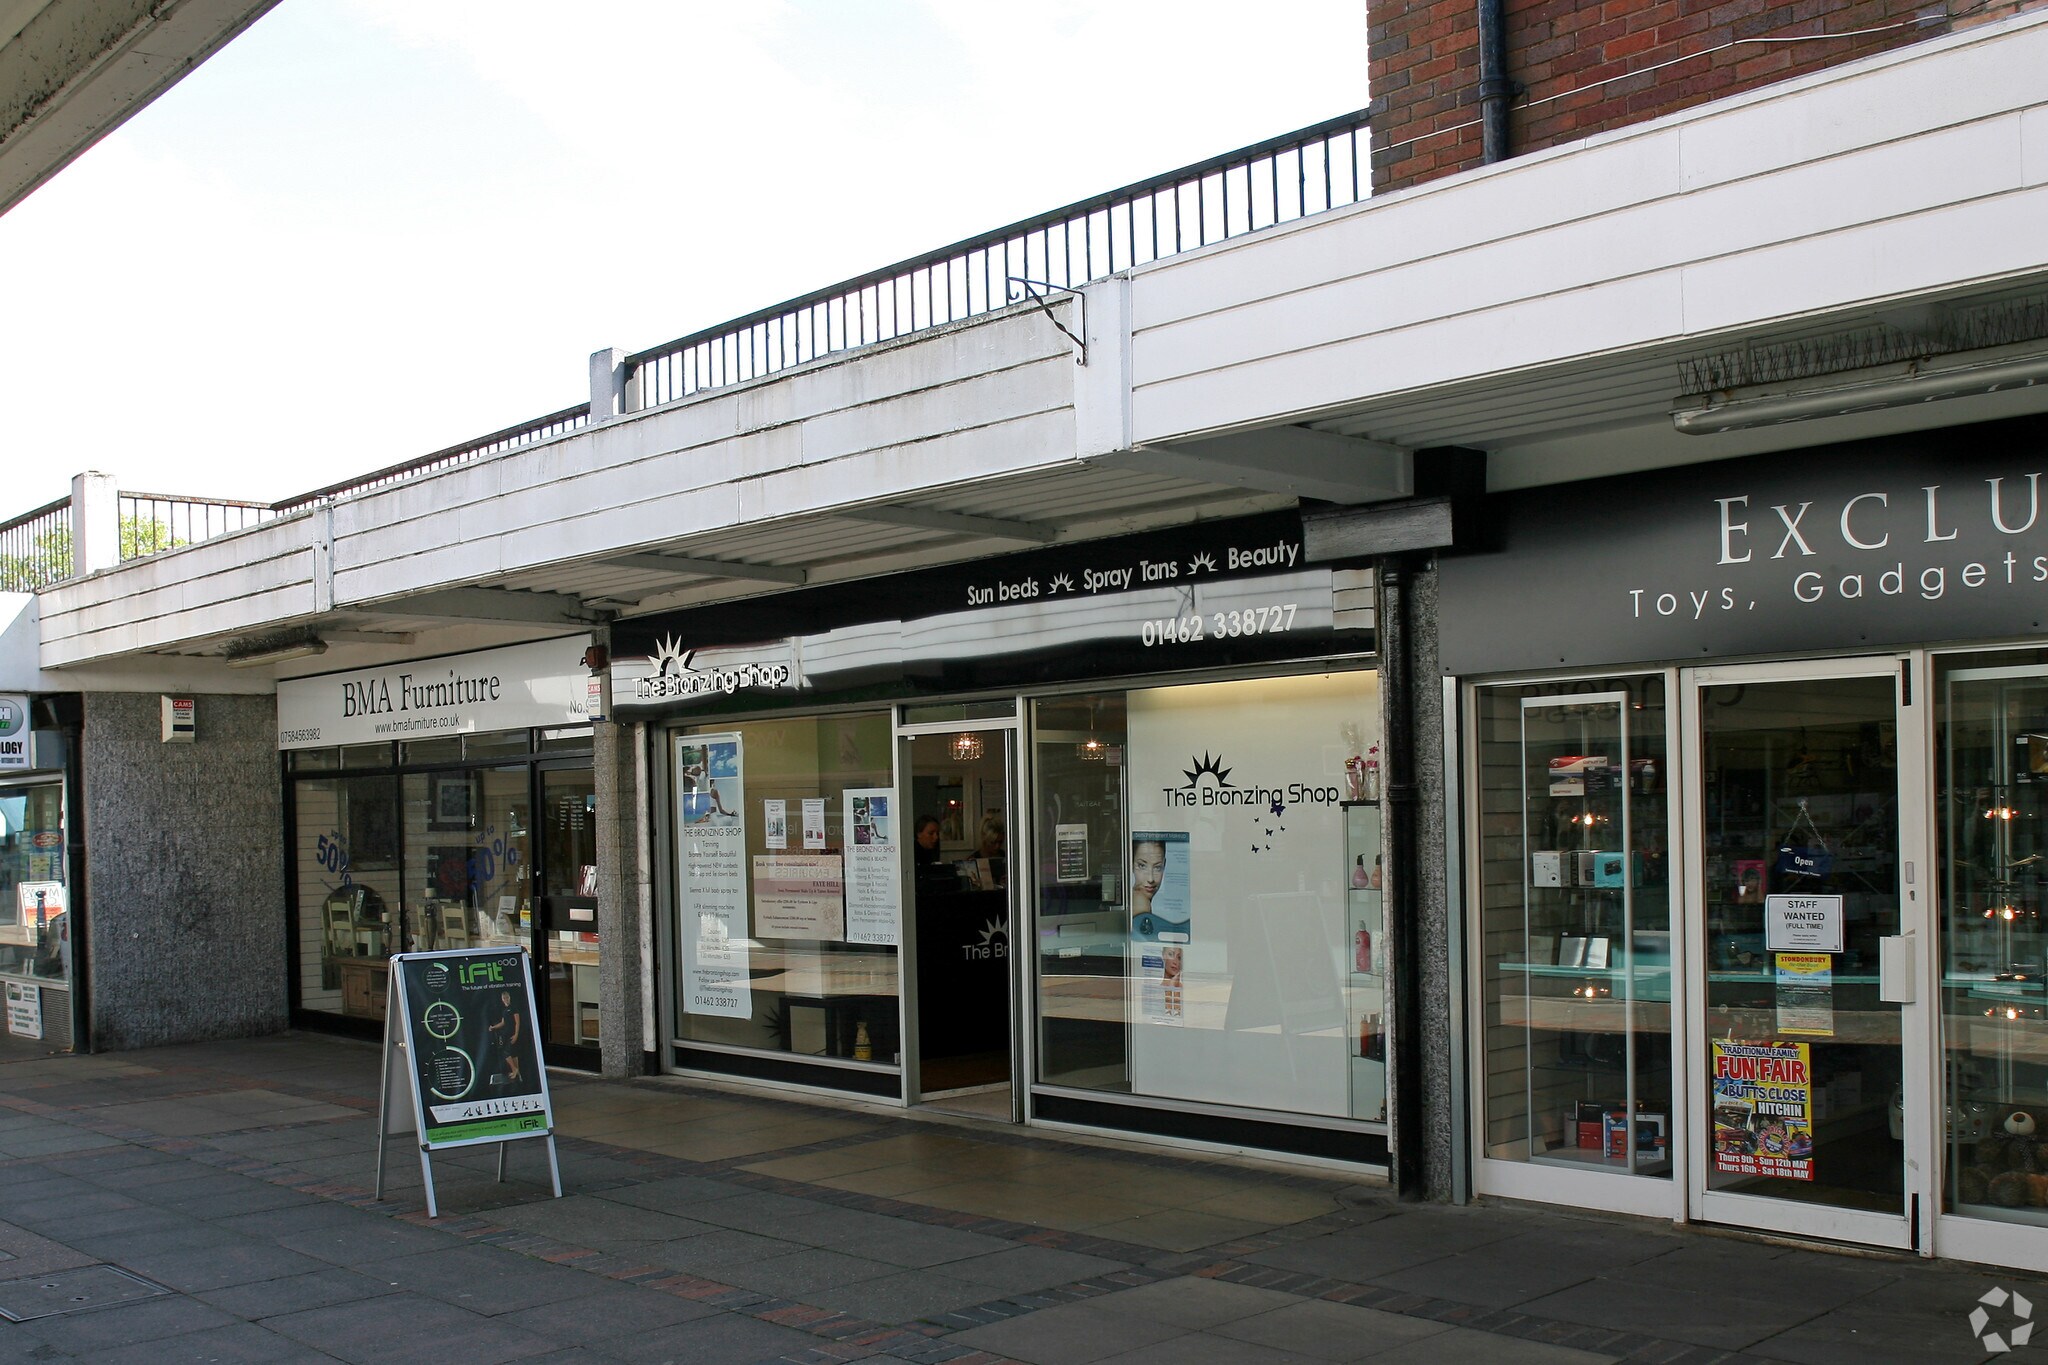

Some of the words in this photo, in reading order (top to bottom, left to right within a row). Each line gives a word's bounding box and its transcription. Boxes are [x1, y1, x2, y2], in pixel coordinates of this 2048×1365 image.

[967, 585, 993, 605] Sun
[999, 577, 1040, 602] beds
[1083, 566, 1133, 594] Spray
[1139, 558, 1179, 581] Tans
[1228, 540, 1300, 570] Beauty
[1629, 587, 1756, 620] Toys,
[1793, 551, 2048, 602] Gadgets
[1142, 614, 1204, 647] 01462
[1213, 603, 1298, 639] 338727
[632, 677, 662, 699] The
[665, 668, 735, 694] Bronzing
[739, 663, 783, 690] Shop
[342, 677, 394, 717] BMA
[400, 669, 501, 711] Furniture
[374, 713, 460, 733] www.bmafurniture.co.uk
[280, 727, 321, 743] 07584563982
[1163, 788, 1197, 806] The
[1202, 785, 1283, 806] Bronzing
[1288, 783, 1339, 807] Shop
[683, 828, 693, 837] THE
[694, 827, 724, 837] BRONZING
[726, 827, 742, 837] SHOP
[1794, 856, 1814, 866] Open
[1784, 912, 1825, 920] WANTED
[853, 932, 871, 941] 01462
[872, 933, 894, 943] 338727
[962, 944, 990, 960] The
[695, 996, 714, 1006] 01462
[715, 997, 738, 1008] 338727
[1722, 1045, 1771, 1056] TRADITIONAL
[1772, 1048, 1800, 1058] FAMILY
[1717, 1056, 1756, 1080] FUN
[1759, 1058, 1807, 1084] FAIR
[1728, 1084, 1767, 1099] BUTTS
[1768, 1087, 1806, 1102] CLOSE
[1757, 1101, 1802, 1117] HITCHIN
[1718, 1152, 1740, 1163] Thurs
[1741, 1155, 1754, 1164] 9th
[1759, 1157, 1774, 1166] Sun
[1776, 1158, 1791, 1167] 12th
[1792, 1160, 1808, 1169] MAY
[1718, 1162, 1740, 1172] Thurs
[1741, 1164, 1757, 1174] 16th
[1761, 1166, 1775, 1175] Sat
[1793, 1170, 1809, 1179] MAY
